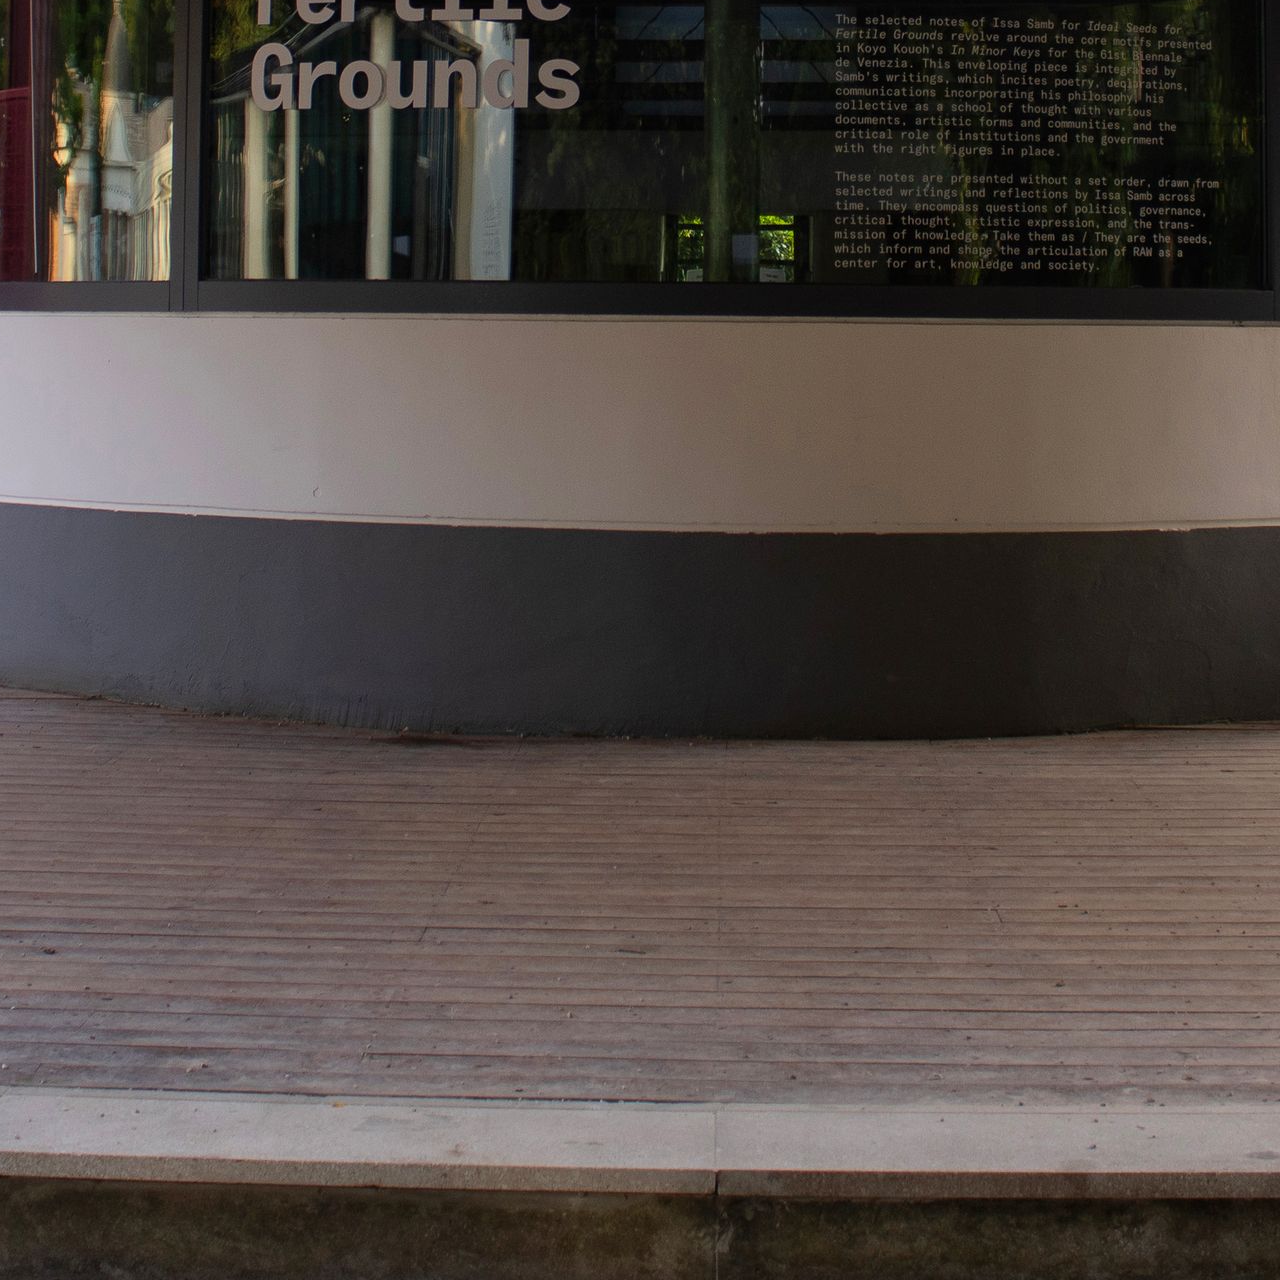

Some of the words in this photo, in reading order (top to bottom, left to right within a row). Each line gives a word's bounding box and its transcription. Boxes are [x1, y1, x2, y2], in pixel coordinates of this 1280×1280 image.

[835, 13, 858, 24] The
[864, 14, 923, 25] selected
[929, 15, 965, 26] notes
[972, 16, 986, 27] of
[992, 17, 1020, 28] Issa
[1027, 18, 1054, 29] Samb
[1060, 19, 1081, 30] for
[1087, 20, 1120, 32] Ideal
[1126, 22, 1158, 33] Seeds
[1164, 23, 1183, 35] for
[834, 28, 886, 39] Fertile
[893, 29, 944, 40] Grounds
[951, 30, 1000, 41] revolve
[1007, 32, 1048, 43] around
[1054, 32, 1075, 44] the
[1081, 37, 1107, 45] core
[1113, 35, 1152, 47] motifs
[1157, 38, 1213, 50] presented
[251, 38, 580, 111] Grounds
[835, 99, 908, 110] collective
[915, 103, 930, 111] as
[936, 103, 944, 111] a
[951, 101, 993, 112] school
[999, 102, 1014, 112] of
[1020, 102, 1068, 116] thought
[1074, 104, 1100, 115] with
[1106, 105, 1152, 117] various
[834, 114, 907, 127] documents,
[915, 115, 972, 126] artistic
[979, 116, 1014, 127] forms
[1020, 117, 1041, 127] and
[1047, 118, 1125, 131] communities,
[1133, 120, 1153, 130] and
[1158, 120, 1178, 131] the
